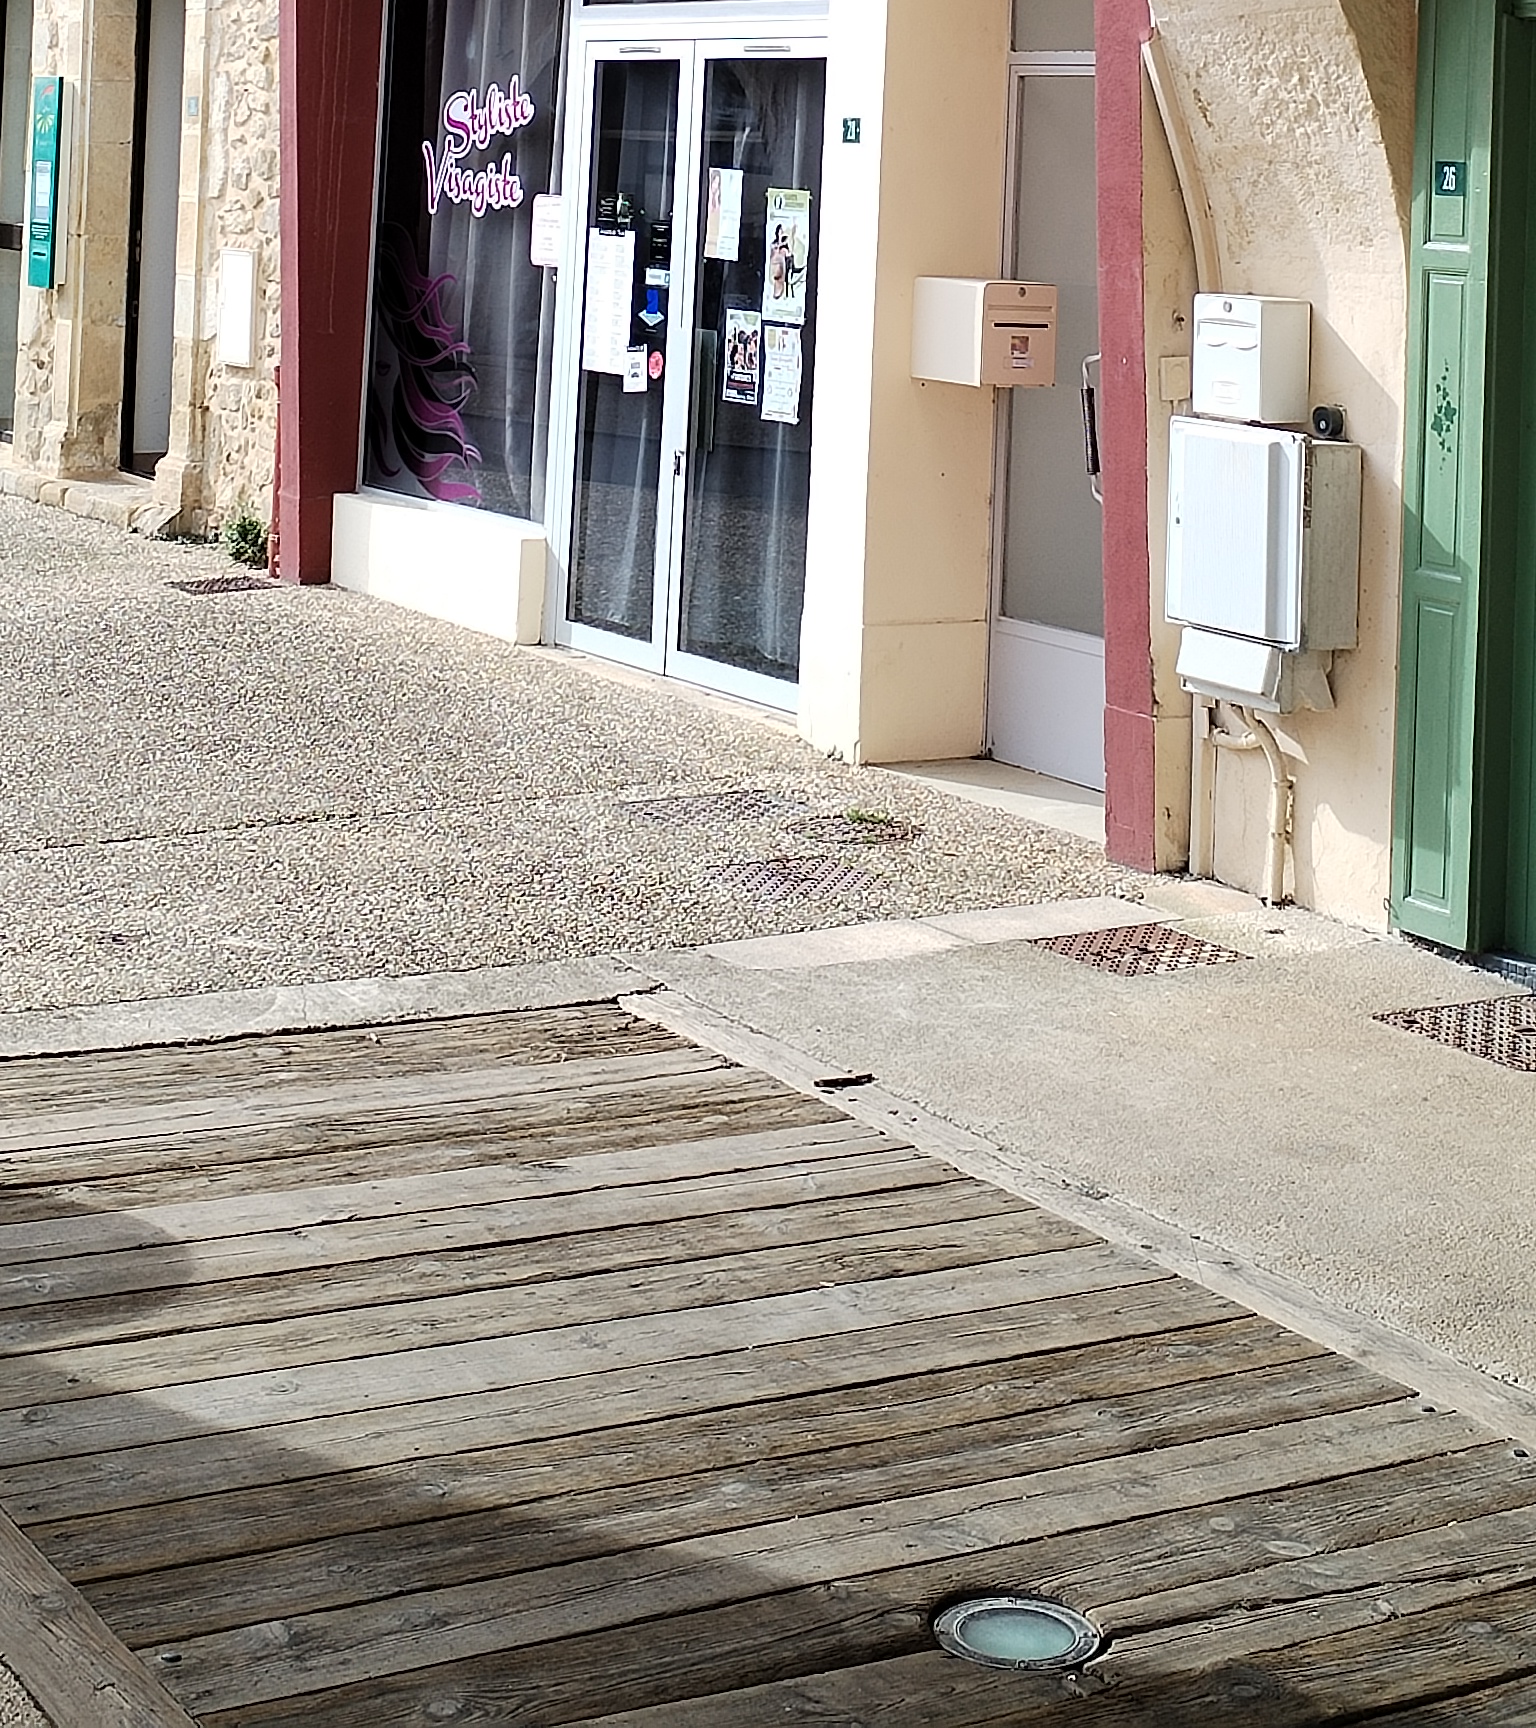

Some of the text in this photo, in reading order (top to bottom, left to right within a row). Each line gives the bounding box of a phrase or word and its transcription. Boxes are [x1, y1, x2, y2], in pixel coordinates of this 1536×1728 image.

[443, 74, 535, 159] Styliste
[421, 135, 524, 218] Visagiste
[1441, 165, 1457, 191] 26
